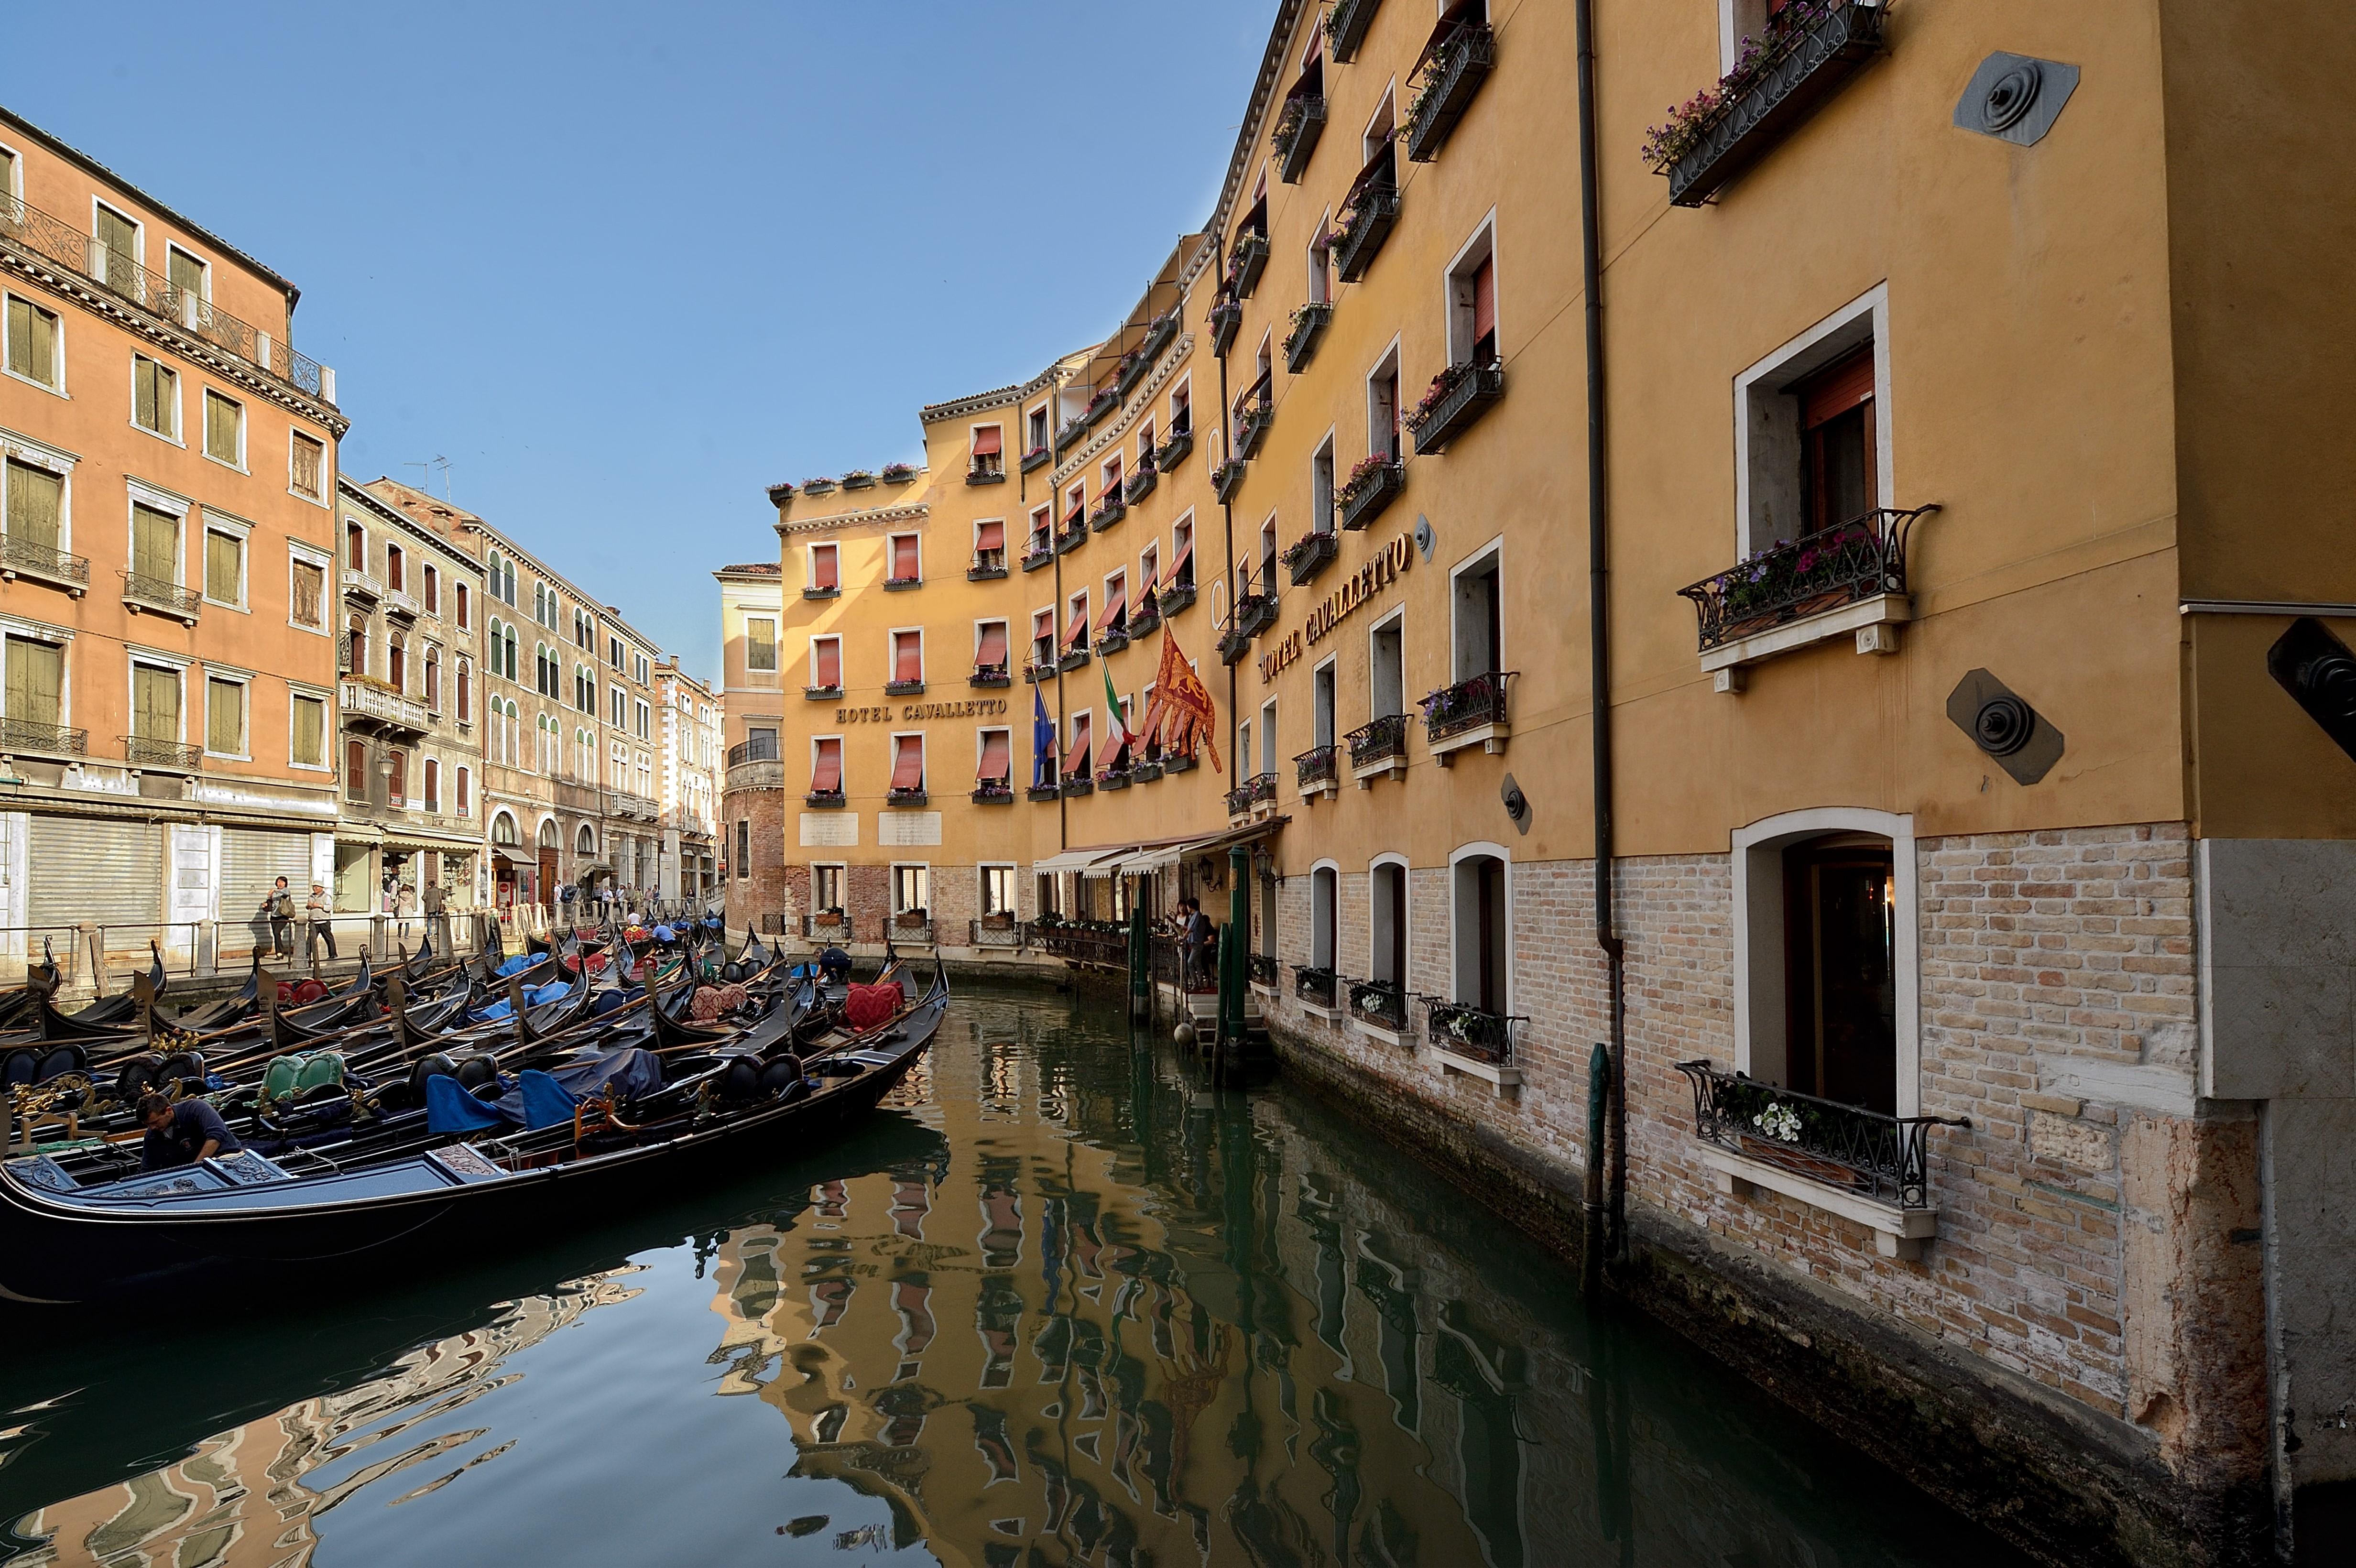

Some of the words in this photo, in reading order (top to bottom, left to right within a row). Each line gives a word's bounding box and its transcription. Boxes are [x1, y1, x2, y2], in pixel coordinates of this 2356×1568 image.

[1262, 629, 1302, 684] HOTEL
[1305, 532, 1413, 646] CAVALLETTO
[836, 707, 892, 723] HOTEL
[902, 698, 1006, 720] CAVALLETTO
